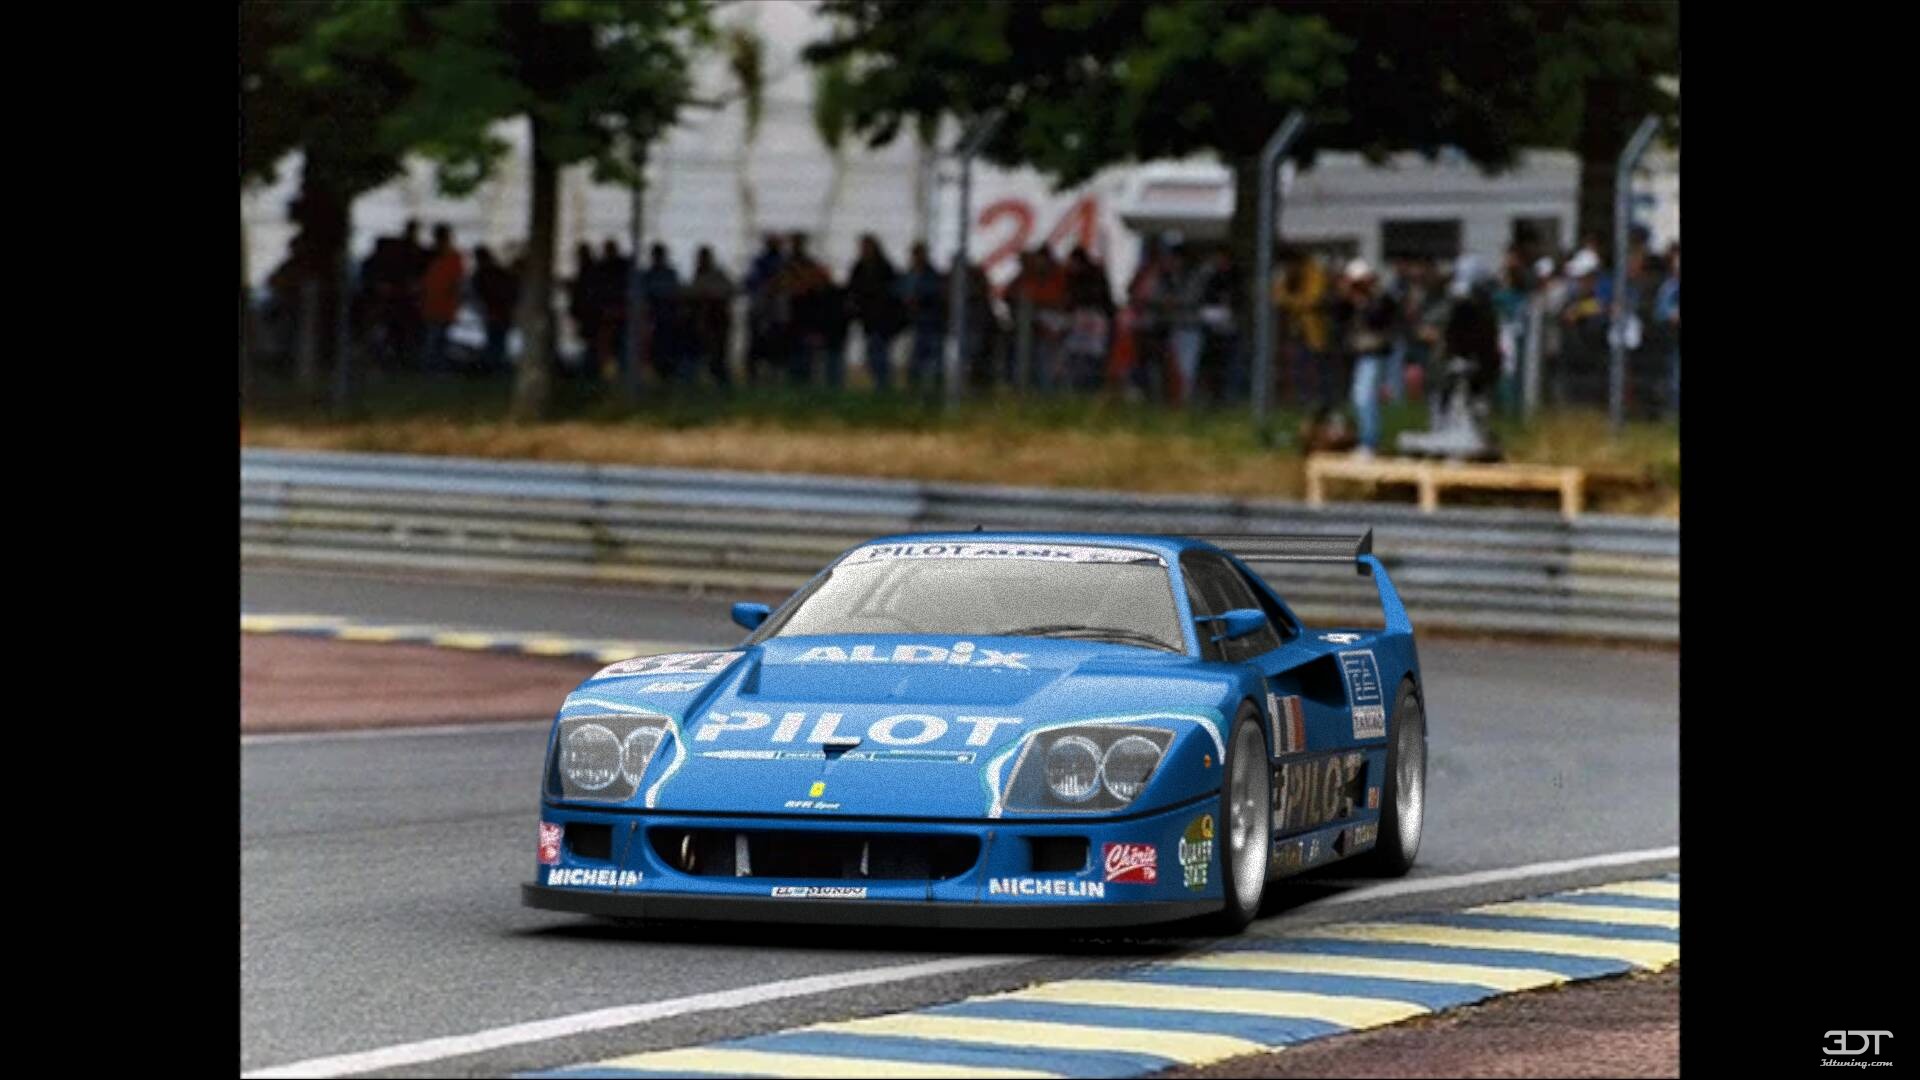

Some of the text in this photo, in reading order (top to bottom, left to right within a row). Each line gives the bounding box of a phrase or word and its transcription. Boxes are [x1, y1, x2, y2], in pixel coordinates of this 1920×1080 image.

[870, 545, 963, 558] PILOT
[695, 711, 1024, 746] PILOT
[989, 878, 1105, 898] MICHELIN
